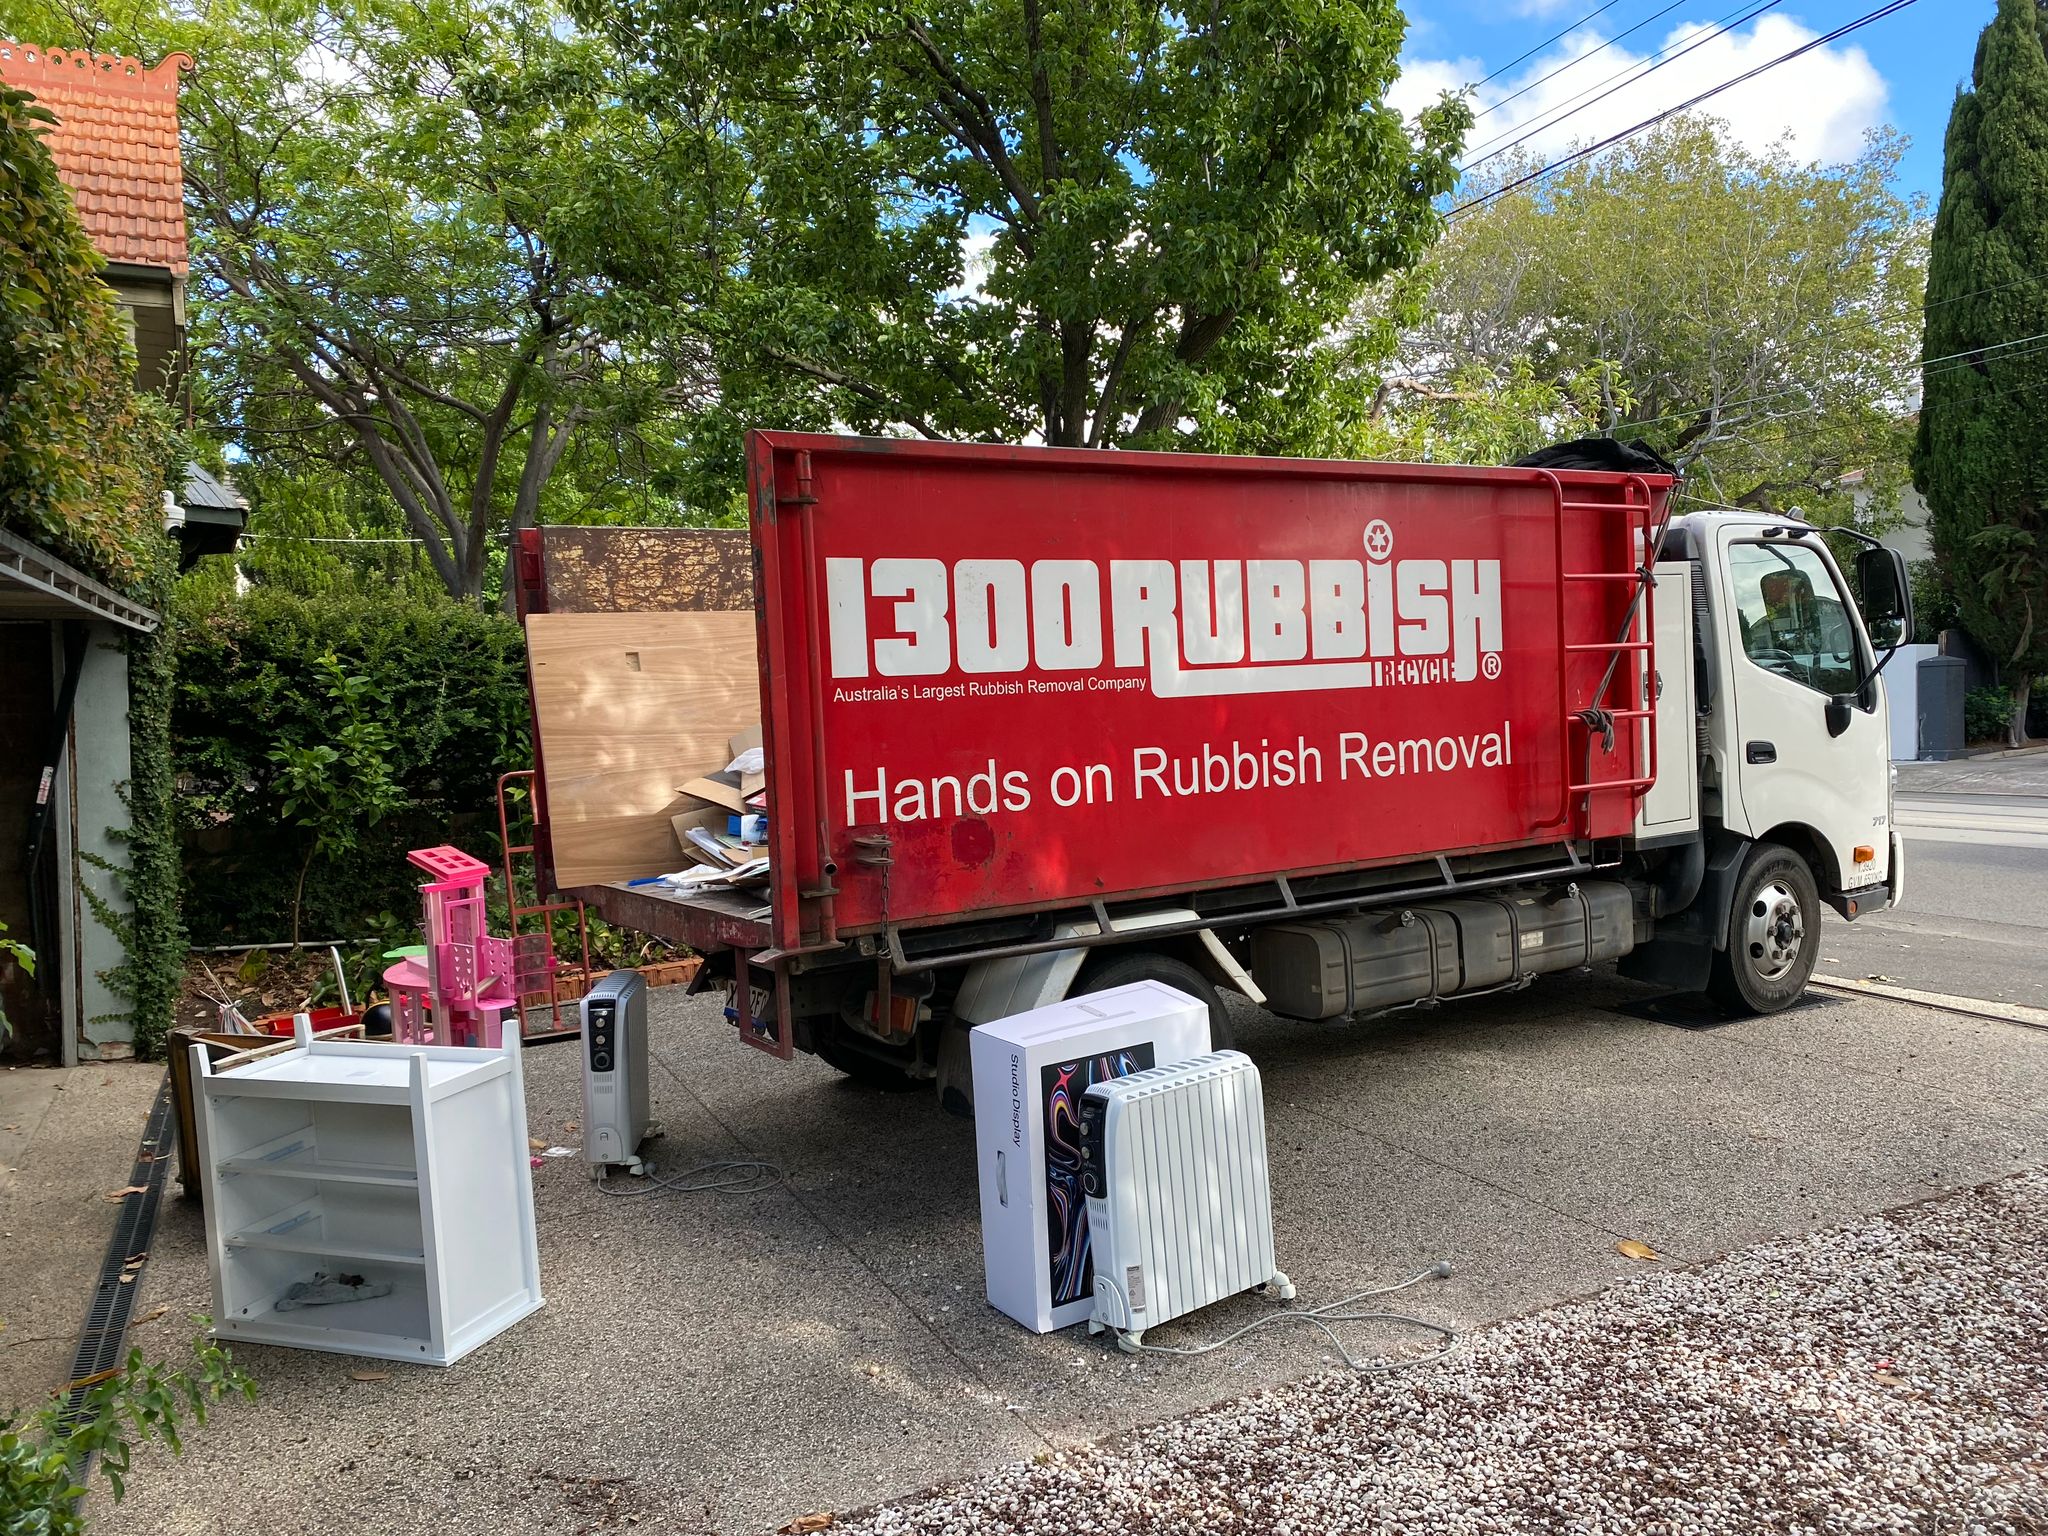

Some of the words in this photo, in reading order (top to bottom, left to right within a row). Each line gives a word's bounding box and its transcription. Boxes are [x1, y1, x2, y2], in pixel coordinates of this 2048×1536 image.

[833, 684, 909, 703] Australia's
[913, 682, 965, 701] Largest
[969, 679, 1023, 696] Rubbish
[1028, 677, 1084, 694] Removal
[1088, 675, 1147, 692] Company
[844, 758, 1031, 827] Hands
[1050, 762, 1113, 807] on
[1133, 736, 1322, 799] Rubbish
[1339, 720, 1512, 781] Removal
[1010, 1053, 1020, 1097] Studio
[1012, 1098, 1022, 1148] Display
